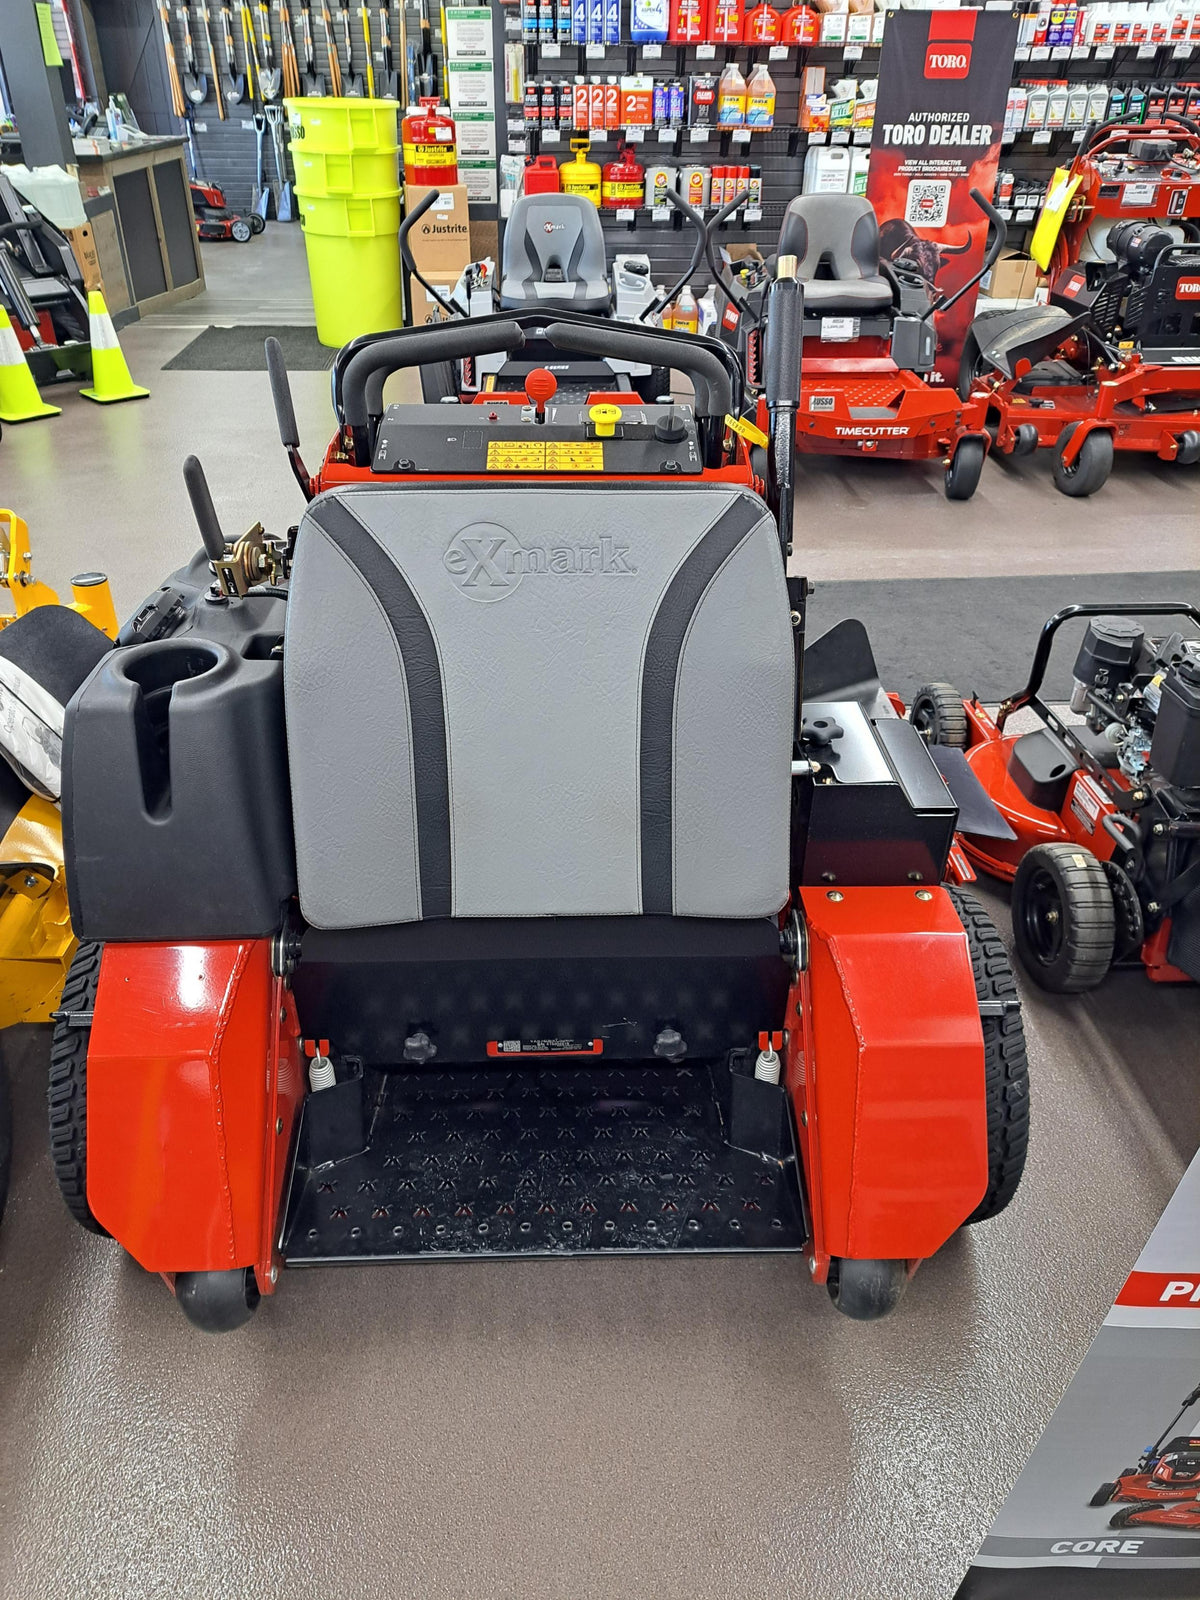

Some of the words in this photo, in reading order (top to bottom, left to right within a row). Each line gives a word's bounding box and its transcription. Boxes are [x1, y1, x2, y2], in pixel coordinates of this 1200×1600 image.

[574, 3, 585, 22] 4
[591, 3, 601, 22] 4
[607, 3, 618, 22] 4
[929, 54, 966, 69] TORO
[576, 88, 587, 107] 2
[593, 88, 603, 107] 2
[607, 88, 617, 107] 2
[626, 95, 636, 111] 2
[908, 112, 970, 123] AUTHORIZED
[882, 124, 925, 146] TORO
[928, 124, 993, 146] DEALER
[432, 223, 468, 234] Justrite
[834, 426, 910, 436] TIMECUTTER
[1049, 1540, 1145, 1555] CORE
